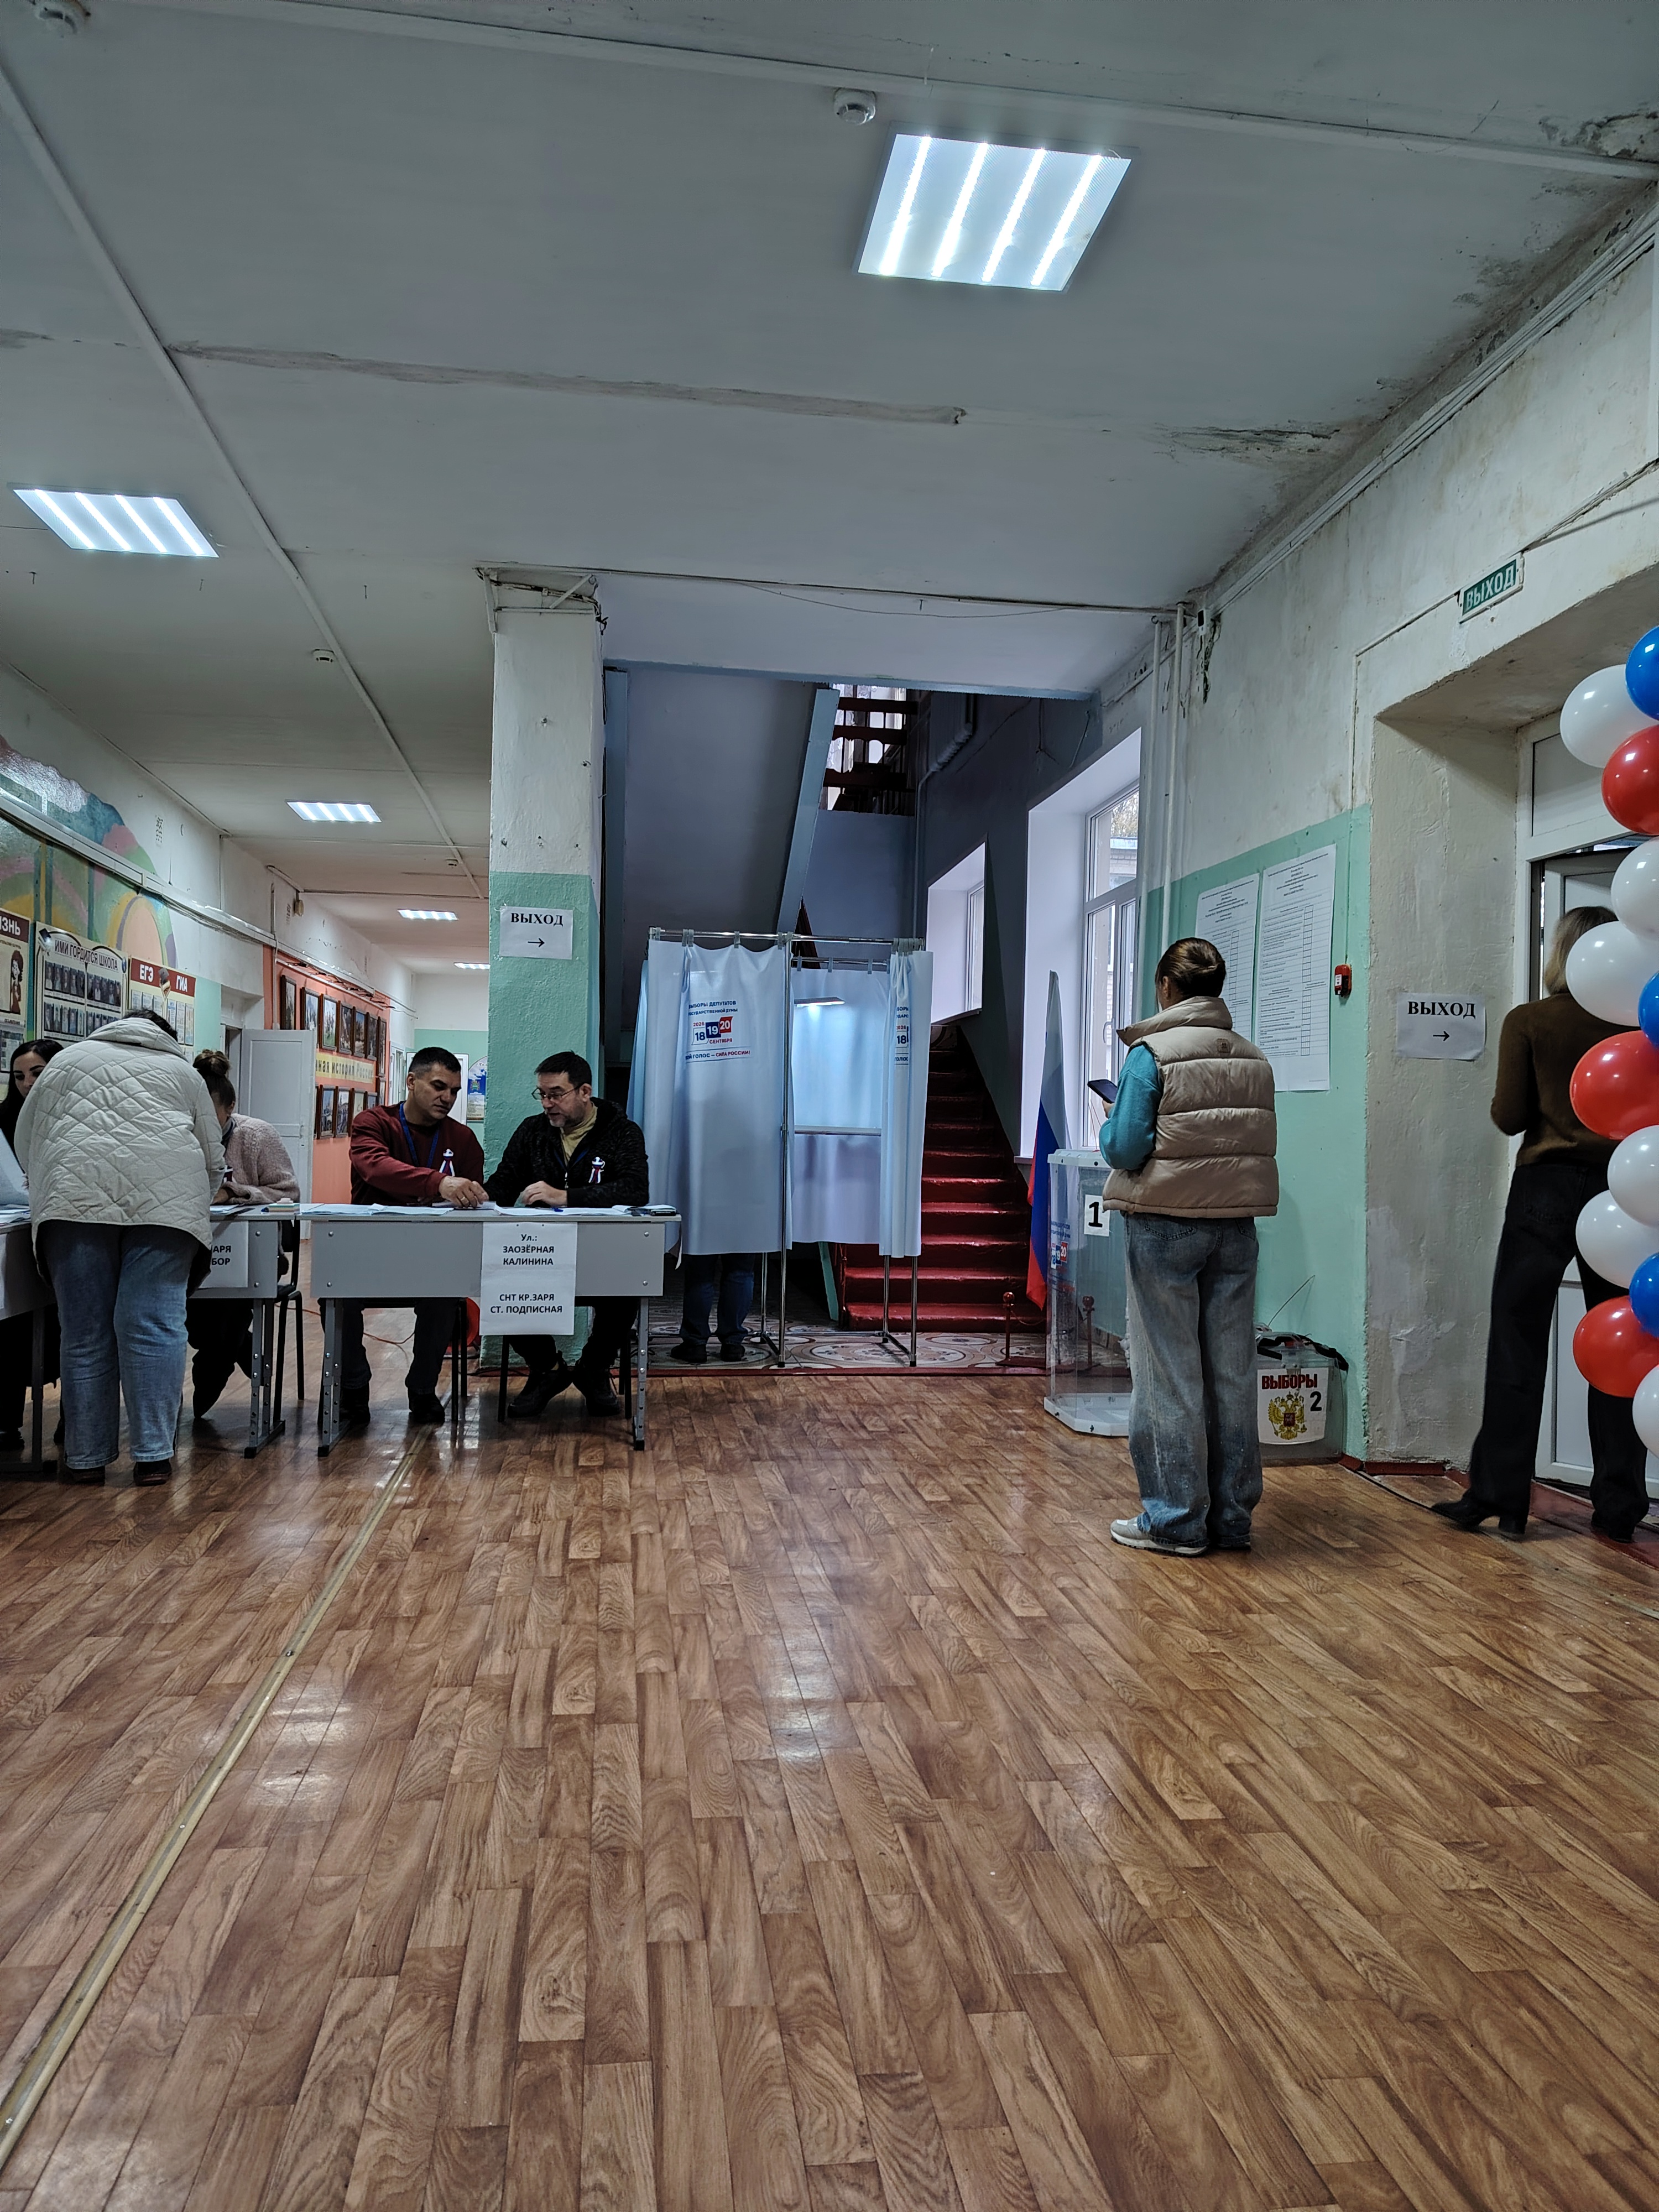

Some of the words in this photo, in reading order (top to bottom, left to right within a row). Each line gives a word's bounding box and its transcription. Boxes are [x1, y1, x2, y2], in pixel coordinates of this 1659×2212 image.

[1465, 565, 1514, 611] ВЫХОД
[511, 912, 564, 927] ВЫХОД
[55, 940, 69, 954] ИМИ
[70, 944, 98, 964] ГОРДИТСЯ
[99, 954, 118, 971] ШКОЛА
[139, 963, 154, 982] ЕГЭ
[176, 975, 188, 992] ГИА
[1407, 1001, 1476, 1019] ВЫХОД
[695, 1031, 706, 1041] 18
[707, 1026, 718, 1035] 19
[719, 1020, 731, 1030] 20
[896, 1035, 906, 1044] 18
[332, 1062, 354, 1079] история
[1088, 1202, 1103, 1228] 1
[503, 1244, 554, 1253] ЗАОЗЁРНАЯ
[1061, 1246, 1067, 1258] 20
[506, 1306, 562, 1314] ПОДПИСНАЯ
[1262, 1374, 1318, 1389] ВЫБОРЫ
[1310, 1391, 1322, 1411] 2
